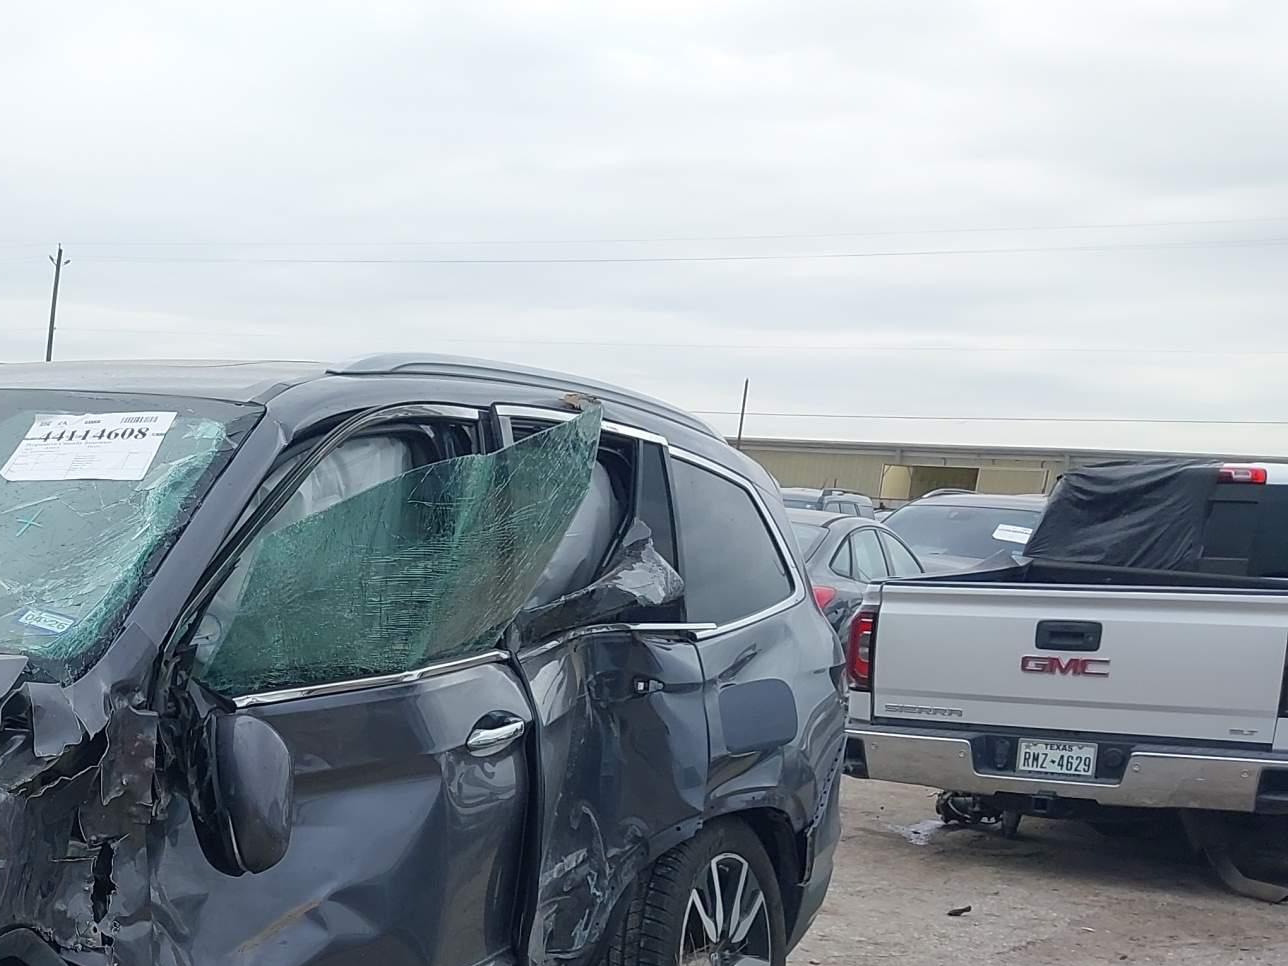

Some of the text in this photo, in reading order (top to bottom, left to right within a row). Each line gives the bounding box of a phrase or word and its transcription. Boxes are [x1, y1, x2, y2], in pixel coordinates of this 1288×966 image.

[39, 426, 150, 442] 44114608
[1021, 655, 1111, 678] GMC
[1044, 743, 1073, 752] TEXAS
